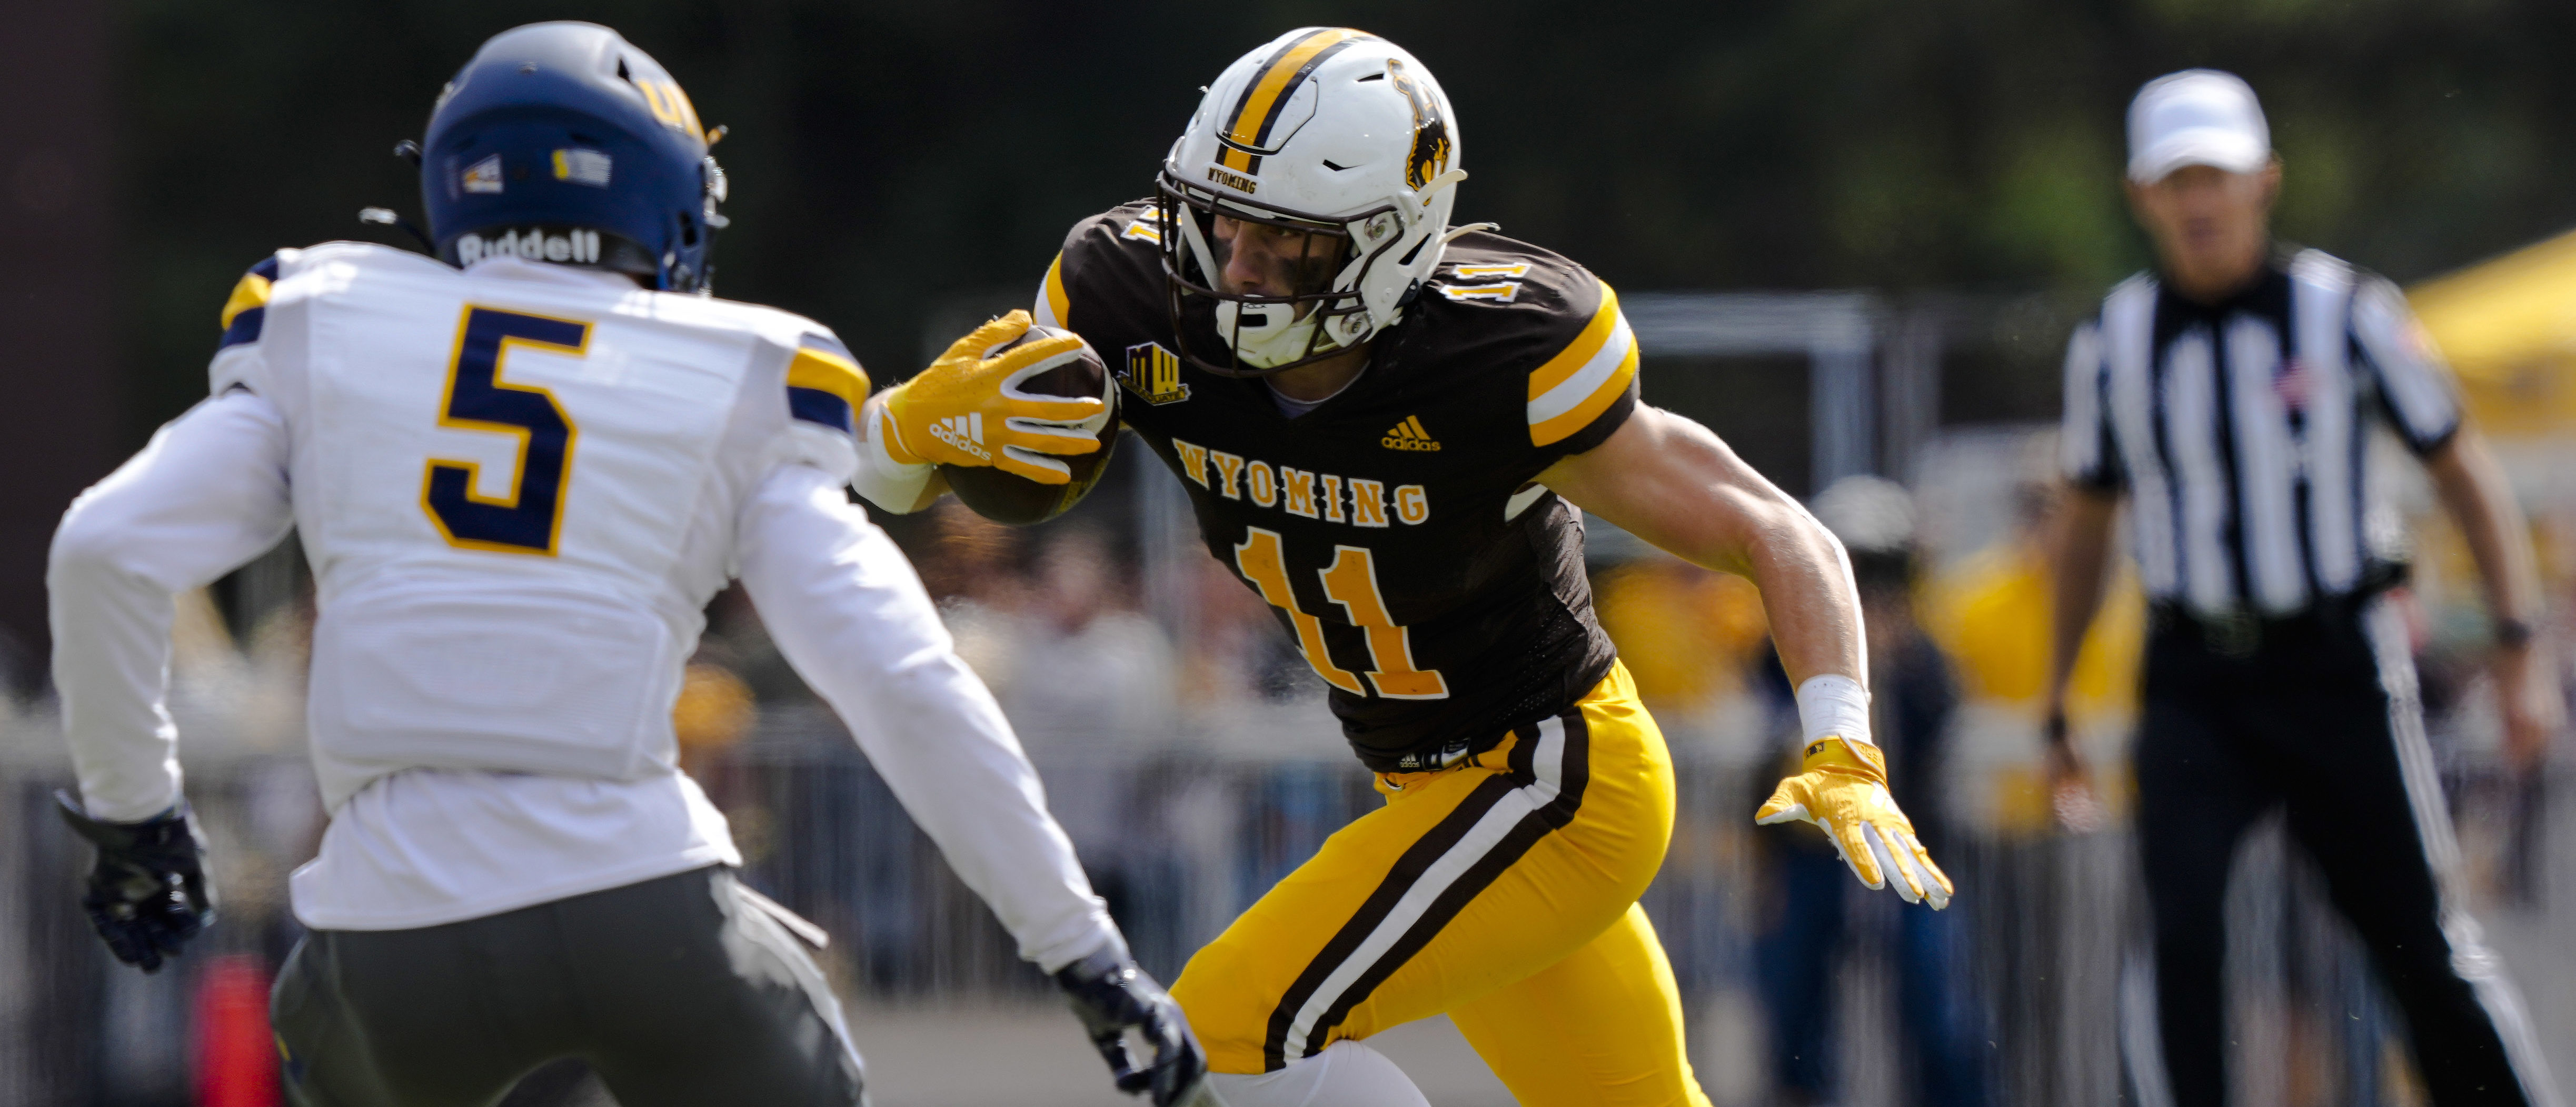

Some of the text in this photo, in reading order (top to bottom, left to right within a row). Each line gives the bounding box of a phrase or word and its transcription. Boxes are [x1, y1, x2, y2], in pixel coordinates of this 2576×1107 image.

[1208, 167, 1257, 194] WYOMING
[457, 227, 599, 267] Riddell
[1439, 262, 1533, 302] 11
[421, 302, 594, 559] 5
[929, 423, 991, 461] adidas
[1381, 436, 1441, 452] adidas
[1172, 437, 1429, 527] WYOMING
[1234, 526, 1450, 700] 11
